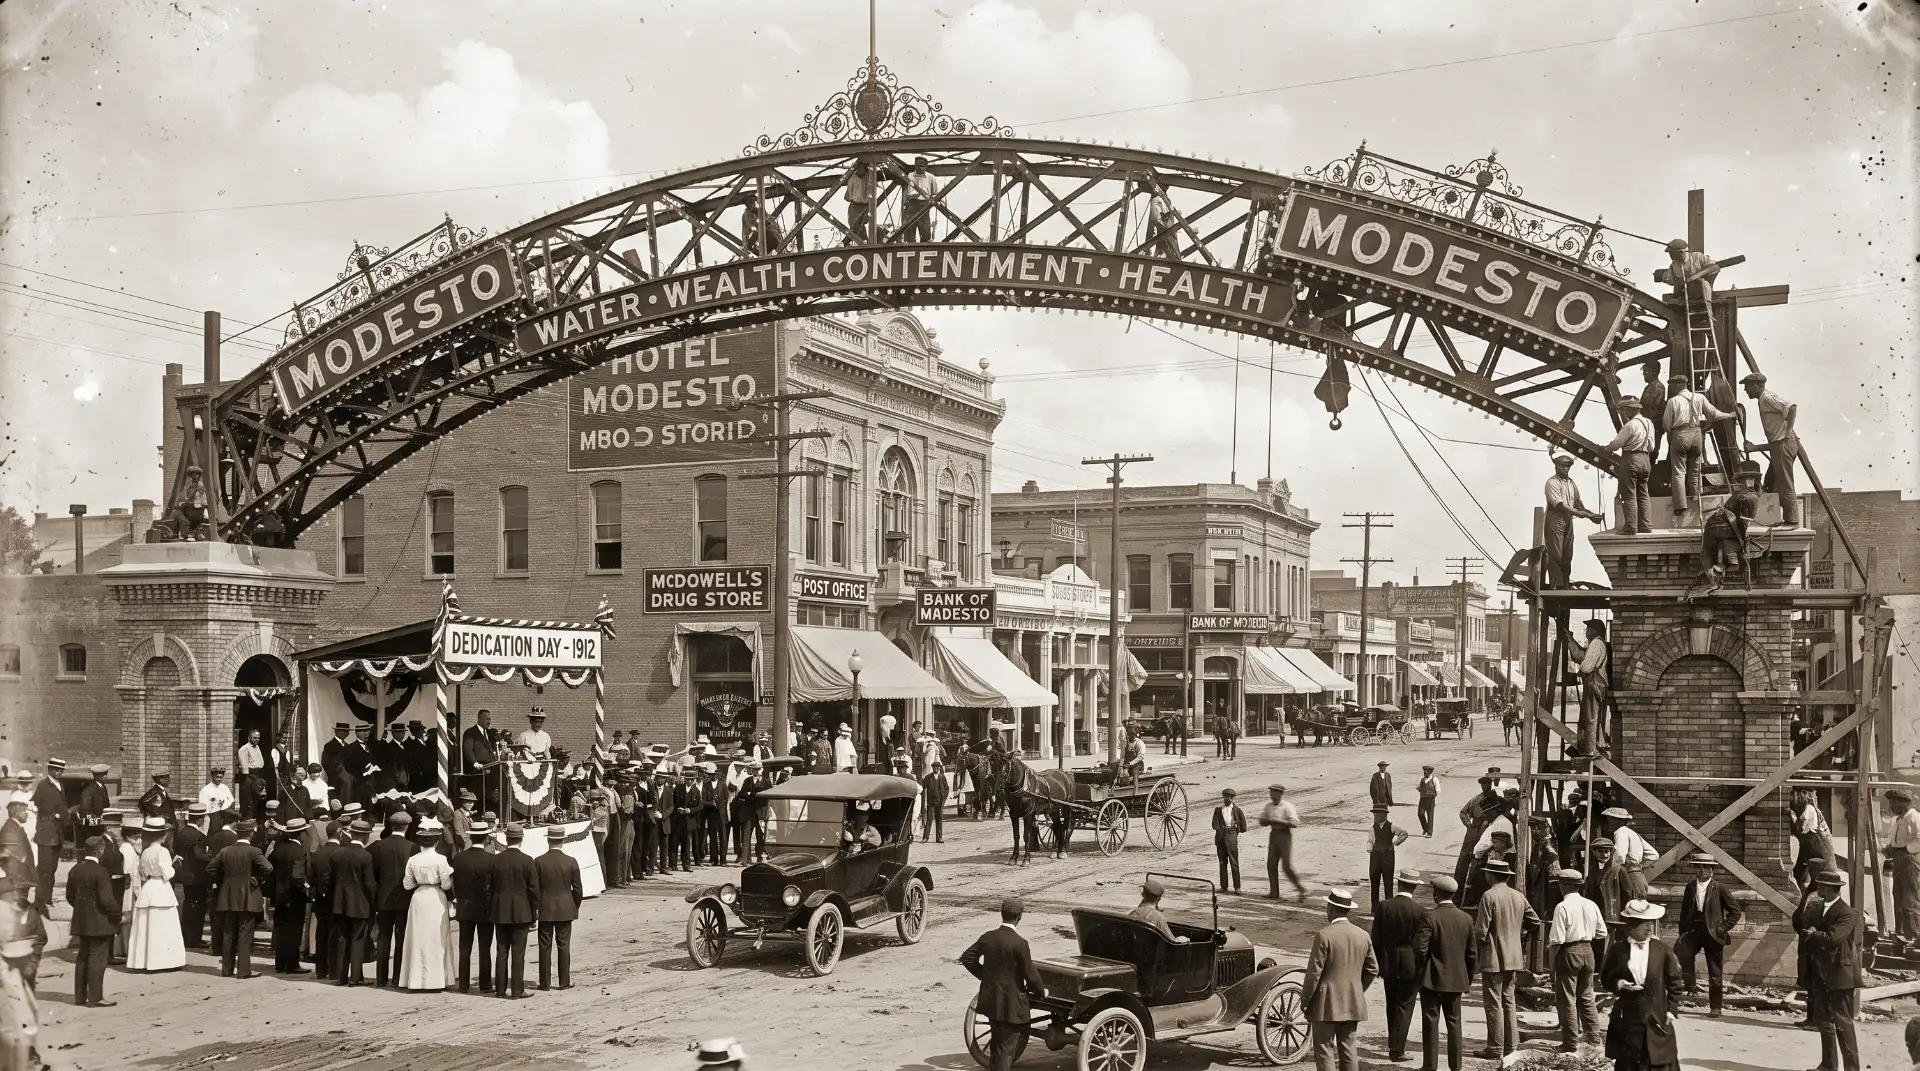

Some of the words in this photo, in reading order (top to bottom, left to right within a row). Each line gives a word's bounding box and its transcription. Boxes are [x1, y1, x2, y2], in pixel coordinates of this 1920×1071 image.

[1298, 207, 1597, 334] MODESTO
[534, 293, 641, 346] WATER
[663, 261, 796, 308] WEALTH
[823, 251, 1092, 285] CONTENTMENT
[1119, 261, 1269, 314] HEALTH
[289, 264, 500, 398] MODESTO
[611, 338, 730, 375] HOTEL
[583, 374, 756, 415] MODESTO
[651, 592, 697, 607] DRUG
[705, 591, 763, 607] STORE
[803, 578, 830, 596] POST
[832, 581, 865, 599] OFFICE
[923, 594, 964, 606] BANK
[970, 594, 988, 606] OF
[920, 608, 990, 621] MADESTO
[1192, 617, 1217, 628] BANK
[1219, 617, 1232, 628] OF
[452, 631, 532, 657] DEDICATION
[537, 637, 562, 658] DAY
[572, 638, 596, 659] 1912
